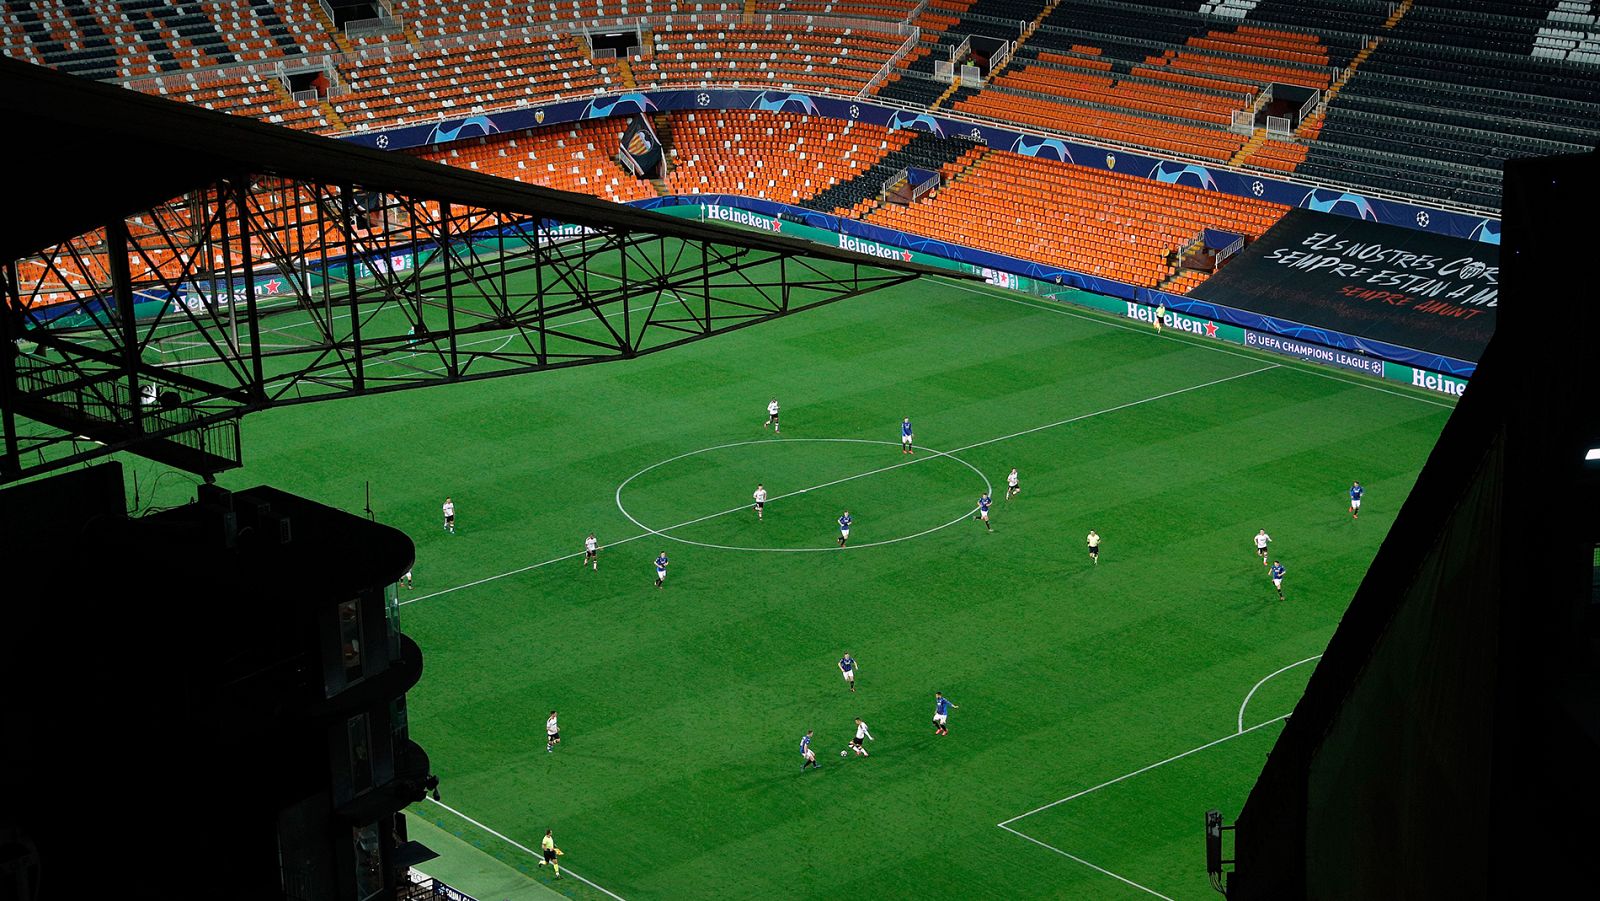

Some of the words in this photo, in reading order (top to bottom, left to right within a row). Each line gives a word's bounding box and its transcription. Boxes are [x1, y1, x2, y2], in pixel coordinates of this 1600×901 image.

[708, 205, 771, 231] Heineken
[838, 234, 900, 261] Heineken
[1302, 232, 1349, 250] ELS
[1342, 243, 1442, 270] NOSTRES
[1264, 248, 1371, 277] SEMPRE
[1366, 269, 1450, 298] ESTAN
[1445, 284, 1474, 299] A
[1336, 285, 1415, 306] SEMPRE
[1412, 299, 1487, 320] AMUNT
[1258, 335, 1281, 350] UEFA
[1282, 341, 1334, 362] CHAMPIONS
[1336, 353, 1370, 370] LEAGUE
